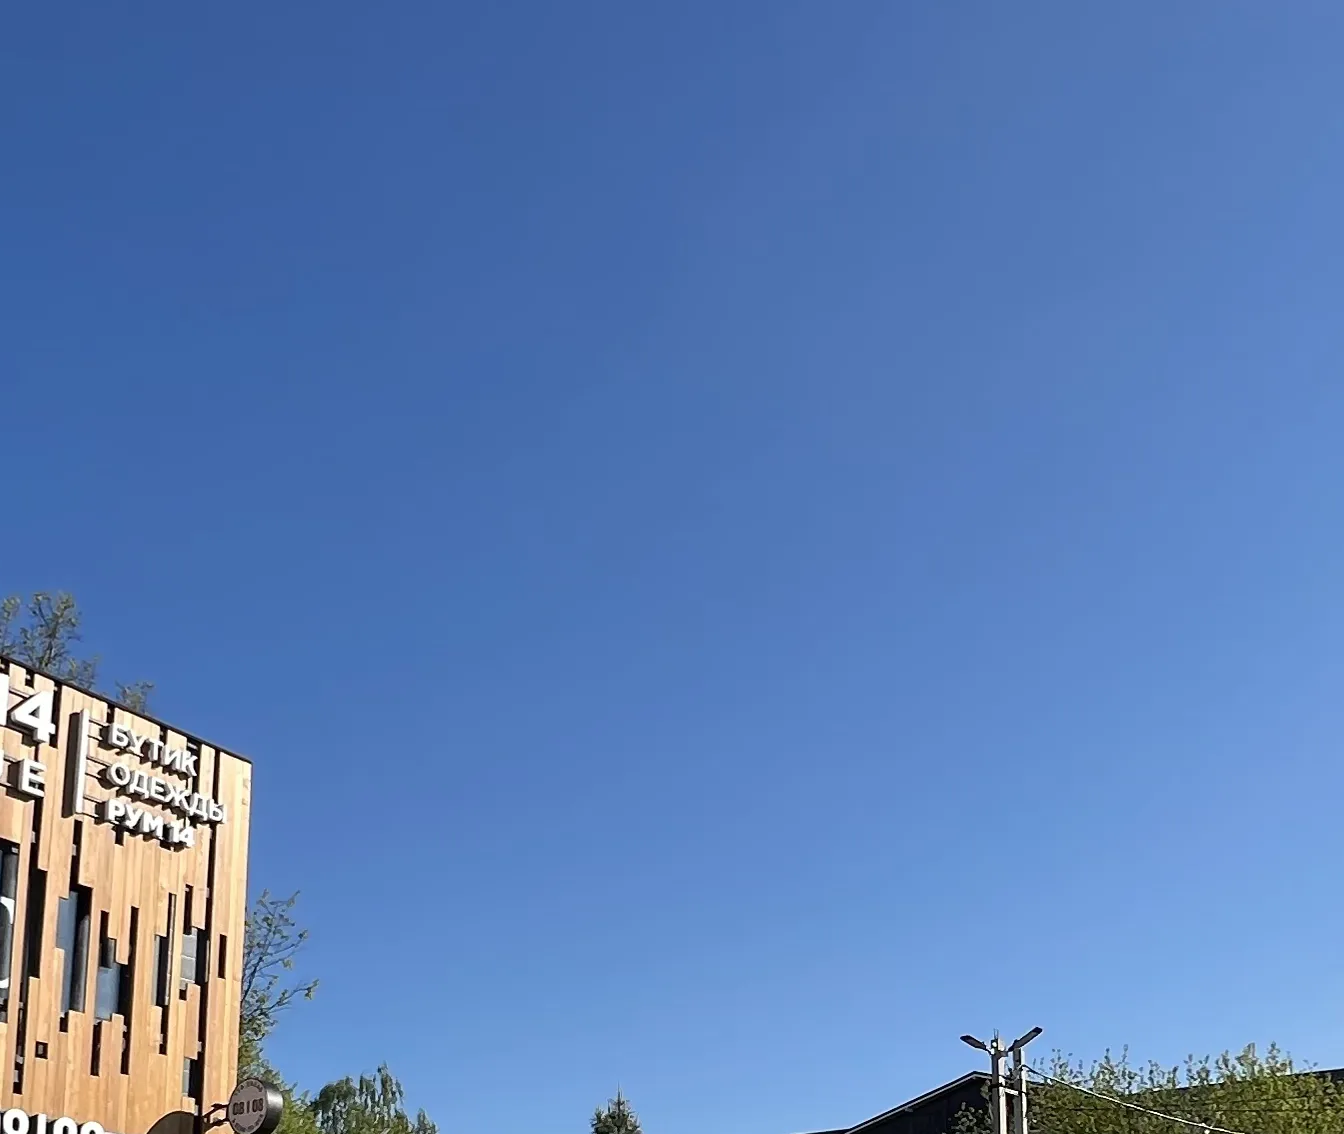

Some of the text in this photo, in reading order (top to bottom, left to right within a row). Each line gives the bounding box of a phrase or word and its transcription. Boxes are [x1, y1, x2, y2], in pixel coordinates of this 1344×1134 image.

[108, 722, 198, 777] БУТИК
[107, 761, 227, 825] ОДЕЖДЫ
[105, 799, 196, 848] РУМ 14
